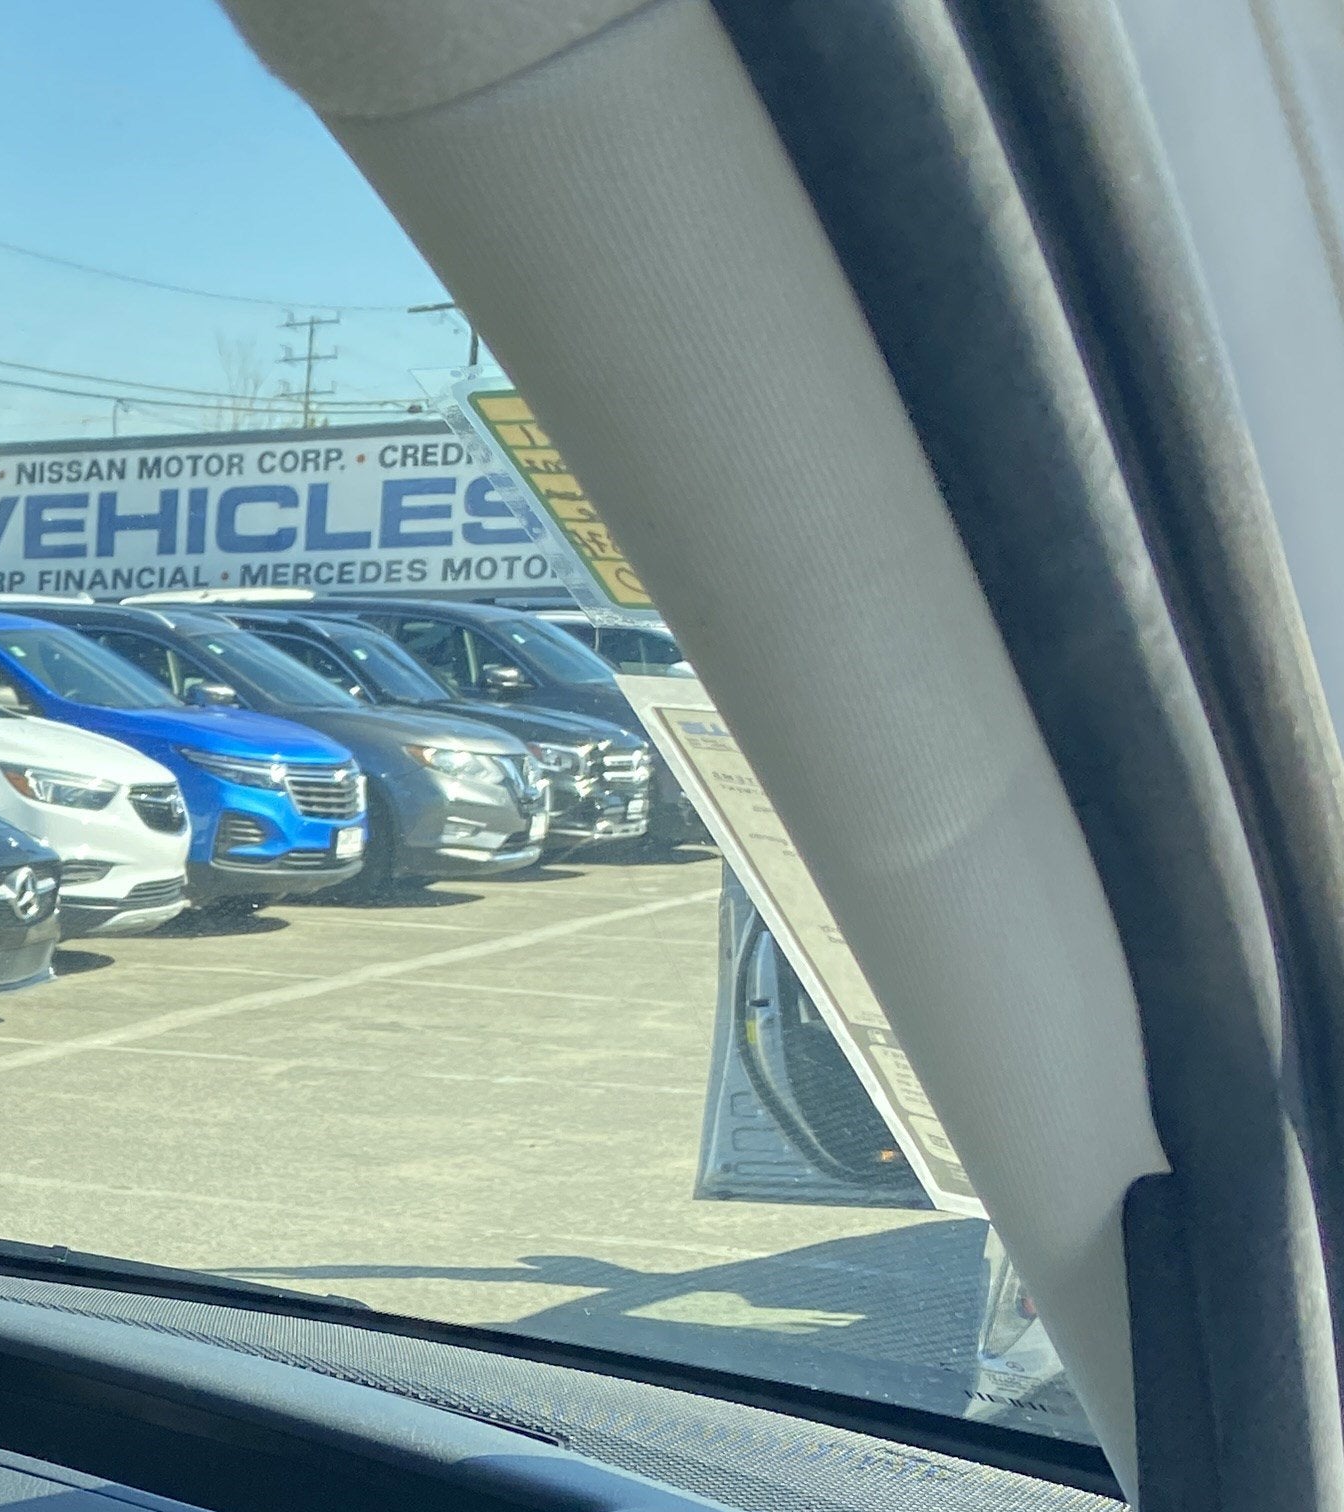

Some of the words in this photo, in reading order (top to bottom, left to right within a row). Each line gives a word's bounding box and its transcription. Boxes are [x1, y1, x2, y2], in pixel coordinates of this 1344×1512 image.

[15, 457, 127, 485] NISSAN
[137, 453, 244, 480] MOTOR
[257, 447, 347, 474] CORP.
[38, 564, 210, 592] FINANCIAL
[239, 558, 427, 587] MERCEDES
